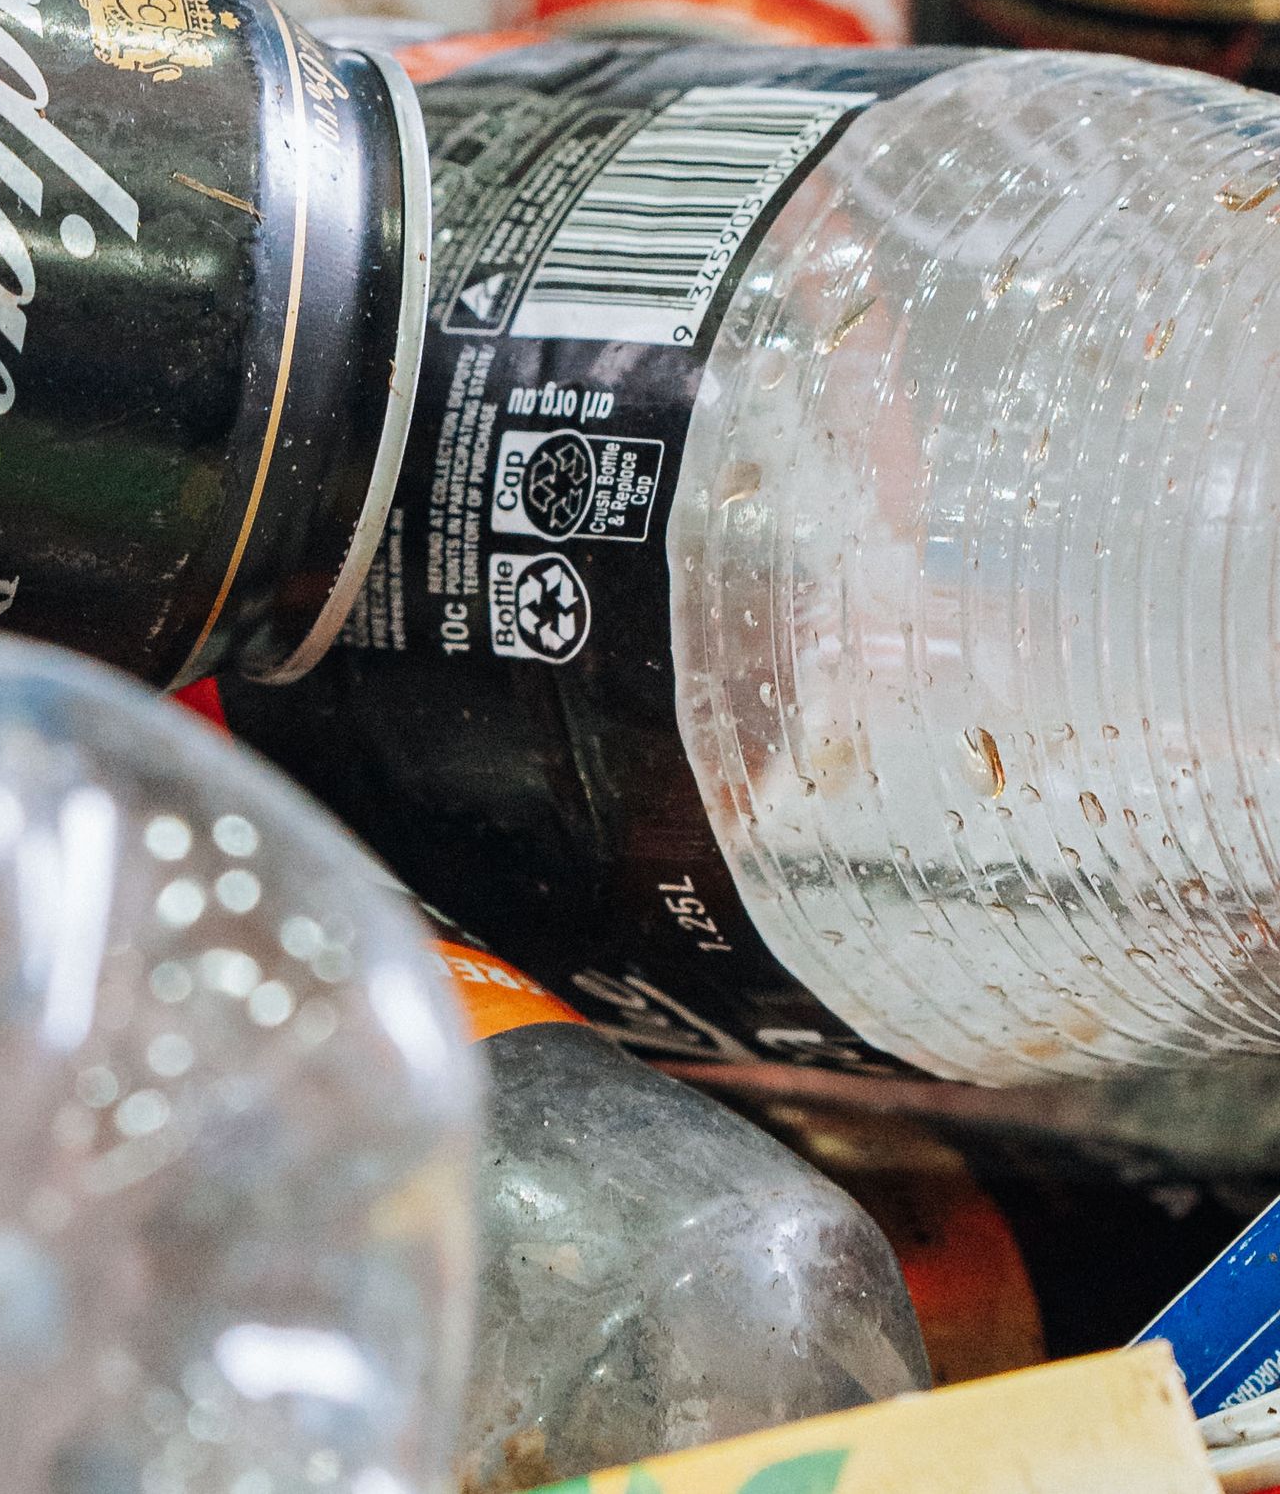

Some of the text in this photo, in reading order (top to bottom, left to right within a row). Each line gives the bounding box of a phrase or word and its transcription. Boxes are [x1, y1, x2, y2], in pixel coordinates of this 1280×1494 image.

[495, 449, 524, 510] Cap
[590, 441, 620, 532] Crush Bottle
[611, 451, 637, 510] Replace
[631, 474, 654, 505] Cap
[494, 559, 517, 649] Bottle
[656, 874, 731, 949] 1.25L
